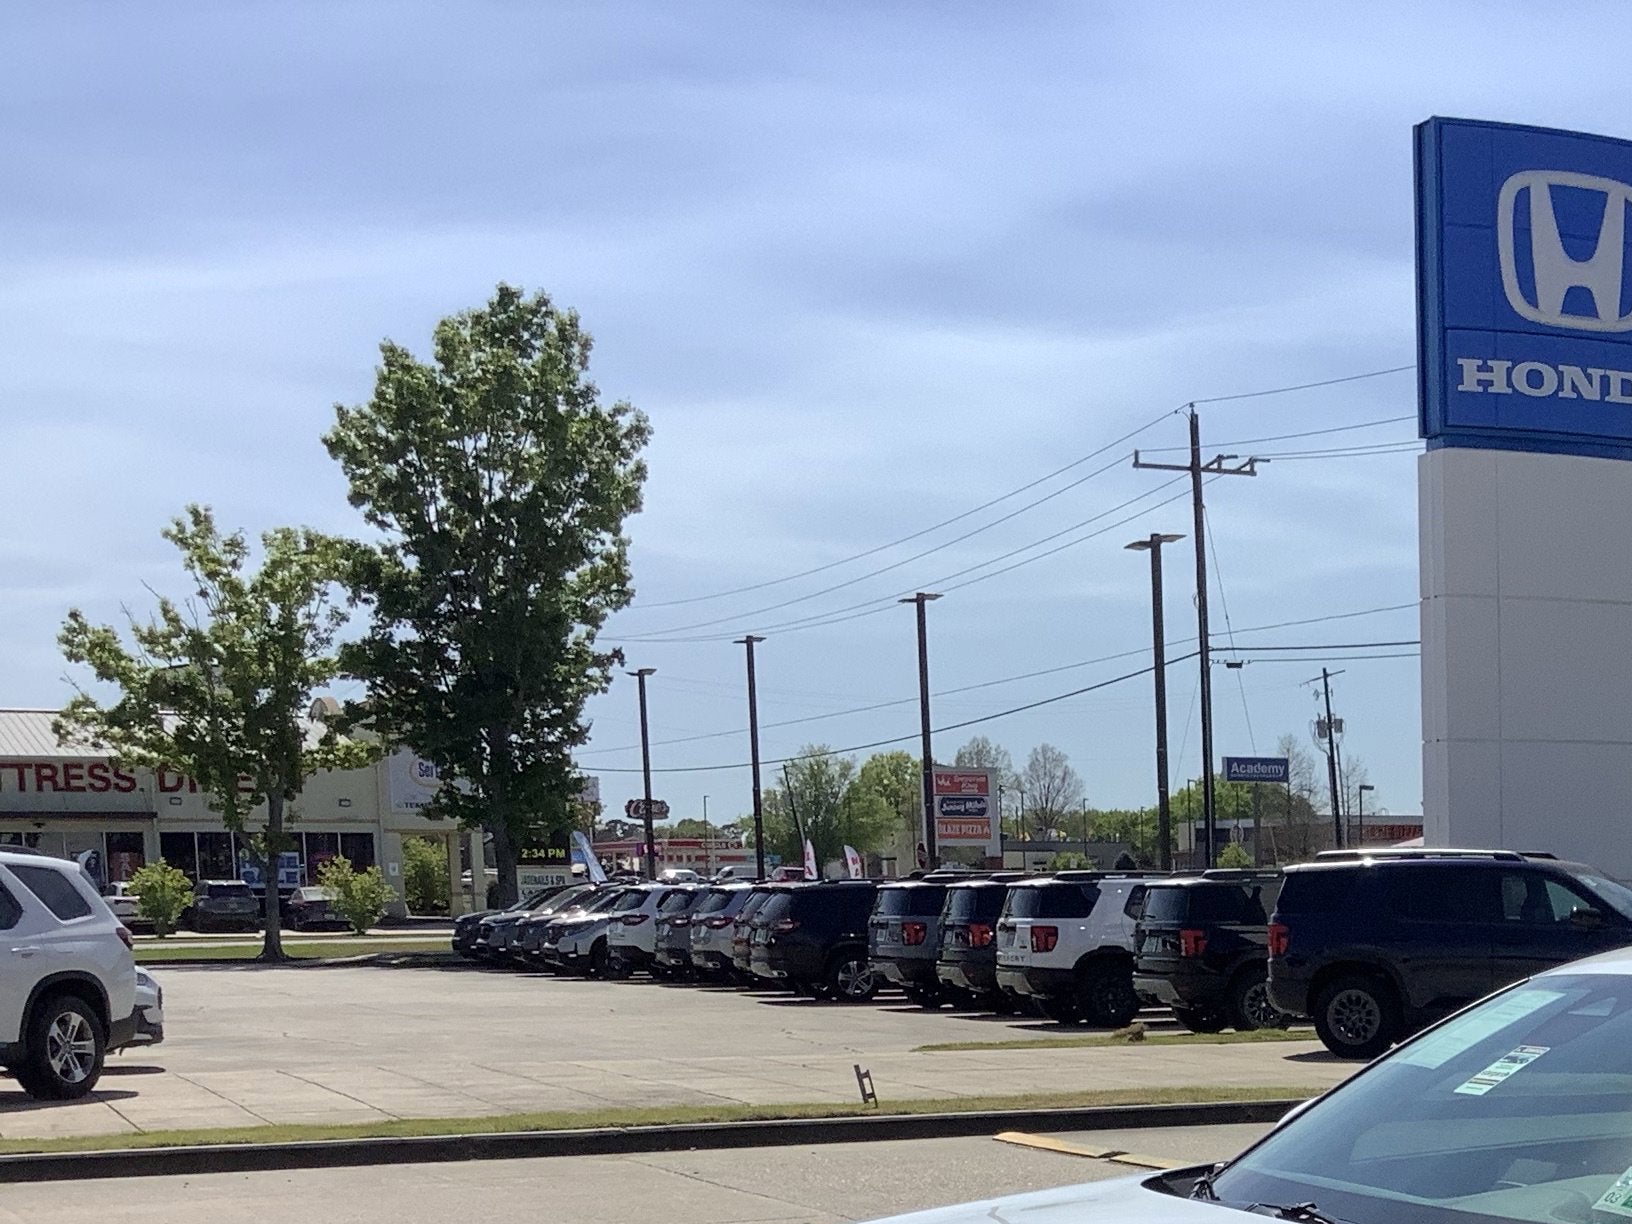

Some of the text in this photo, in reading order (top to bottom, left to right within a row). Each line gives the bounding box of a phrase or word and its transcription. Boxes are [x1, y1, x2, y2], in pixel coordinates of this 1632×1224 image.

[1231, 762, 1285, 777] Academy
[961, 824, 982, 835] PIZZA
[521, 848, 566, 858] 2:34 PM
